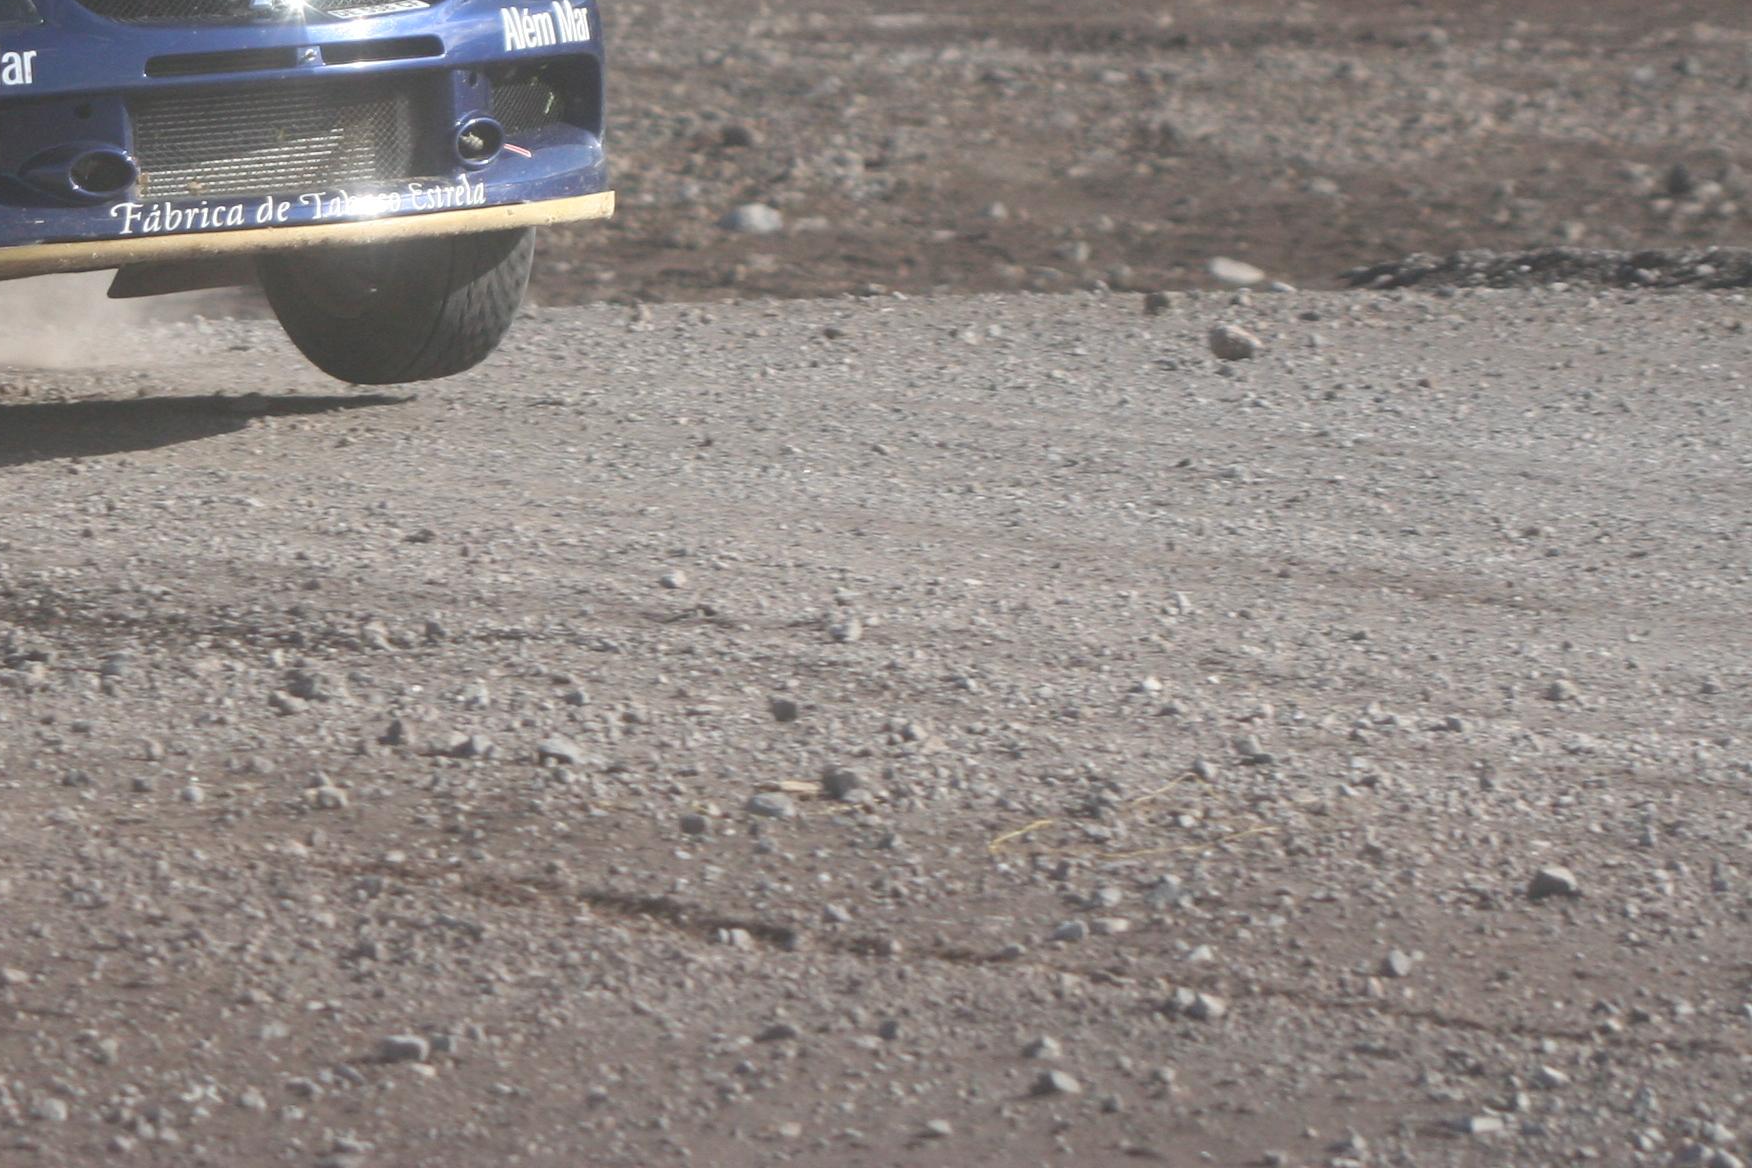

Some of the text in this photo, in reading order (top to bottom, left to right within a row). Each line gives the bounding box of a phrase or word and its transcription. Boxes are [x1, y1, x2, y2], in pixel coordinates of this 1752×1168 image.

[500, 0, 591, 53] Além Mar
[110, 172, 487, 235] Fábrica de Tabo Estrela
